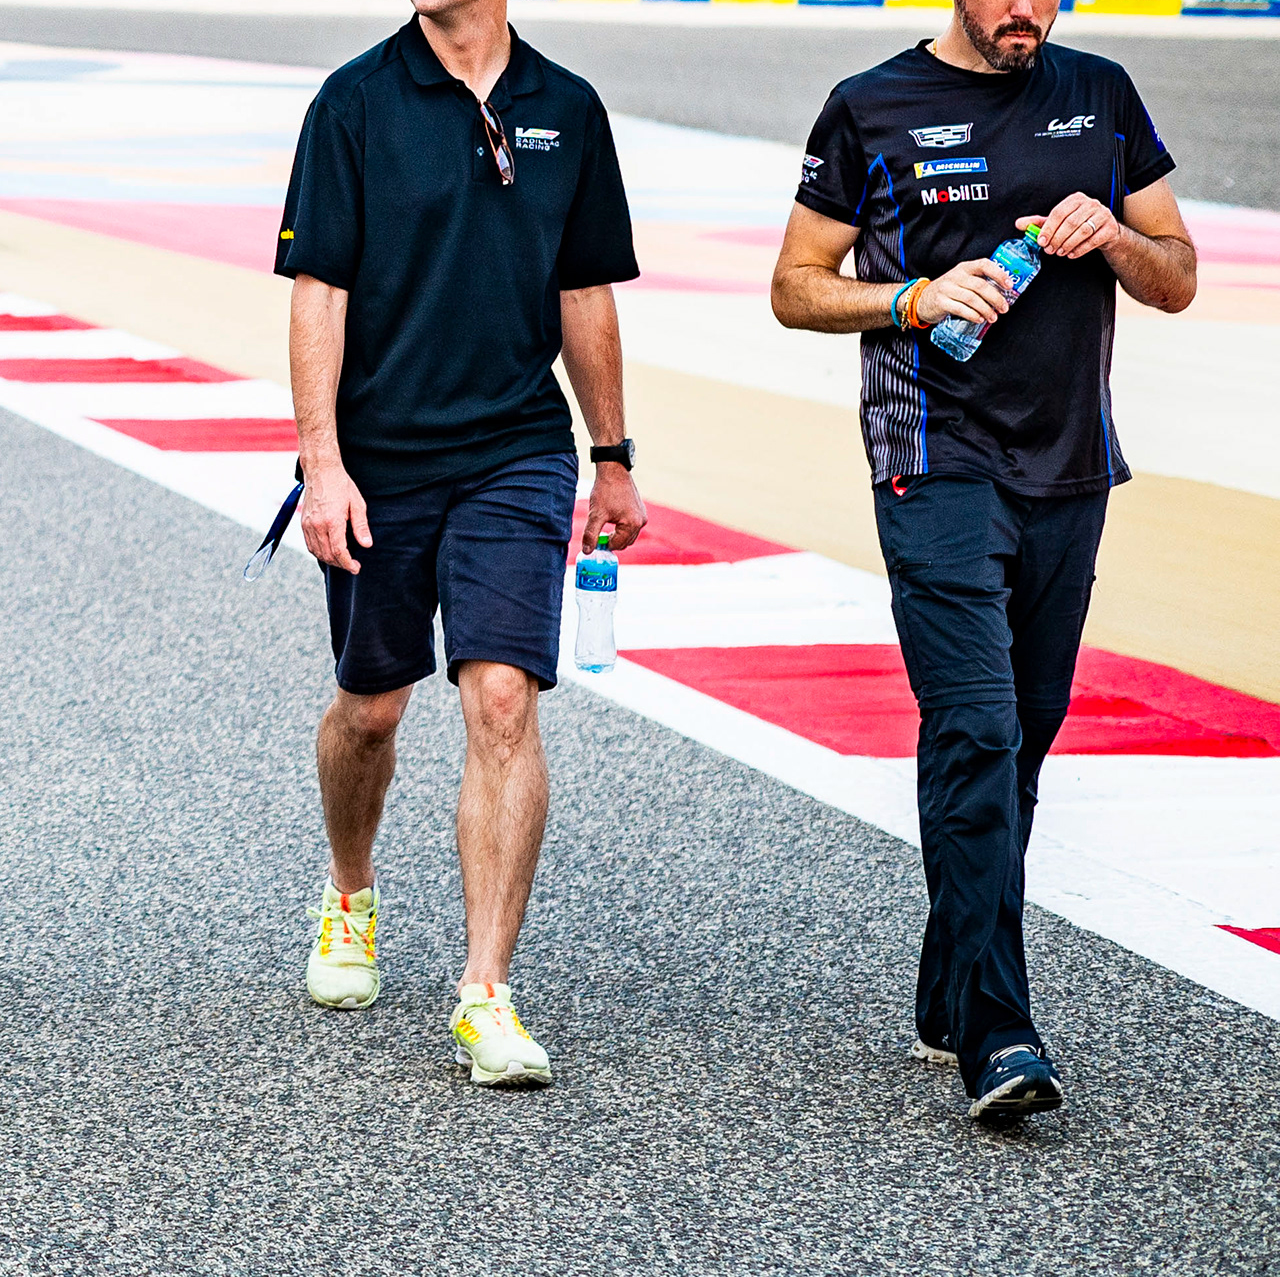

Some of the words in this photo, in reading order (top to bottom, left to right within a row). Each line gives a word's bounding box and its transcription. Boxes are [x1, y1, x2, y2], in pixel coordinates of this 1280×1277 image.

[1047, 115, 1095, 131] WEC
[515, 137, 560, 147] CADILLAC
[515, 142, 551, 151] RACING
[935, 162, 980, 171] MICHELIN
[921, 184, 970, 206] Mobil
